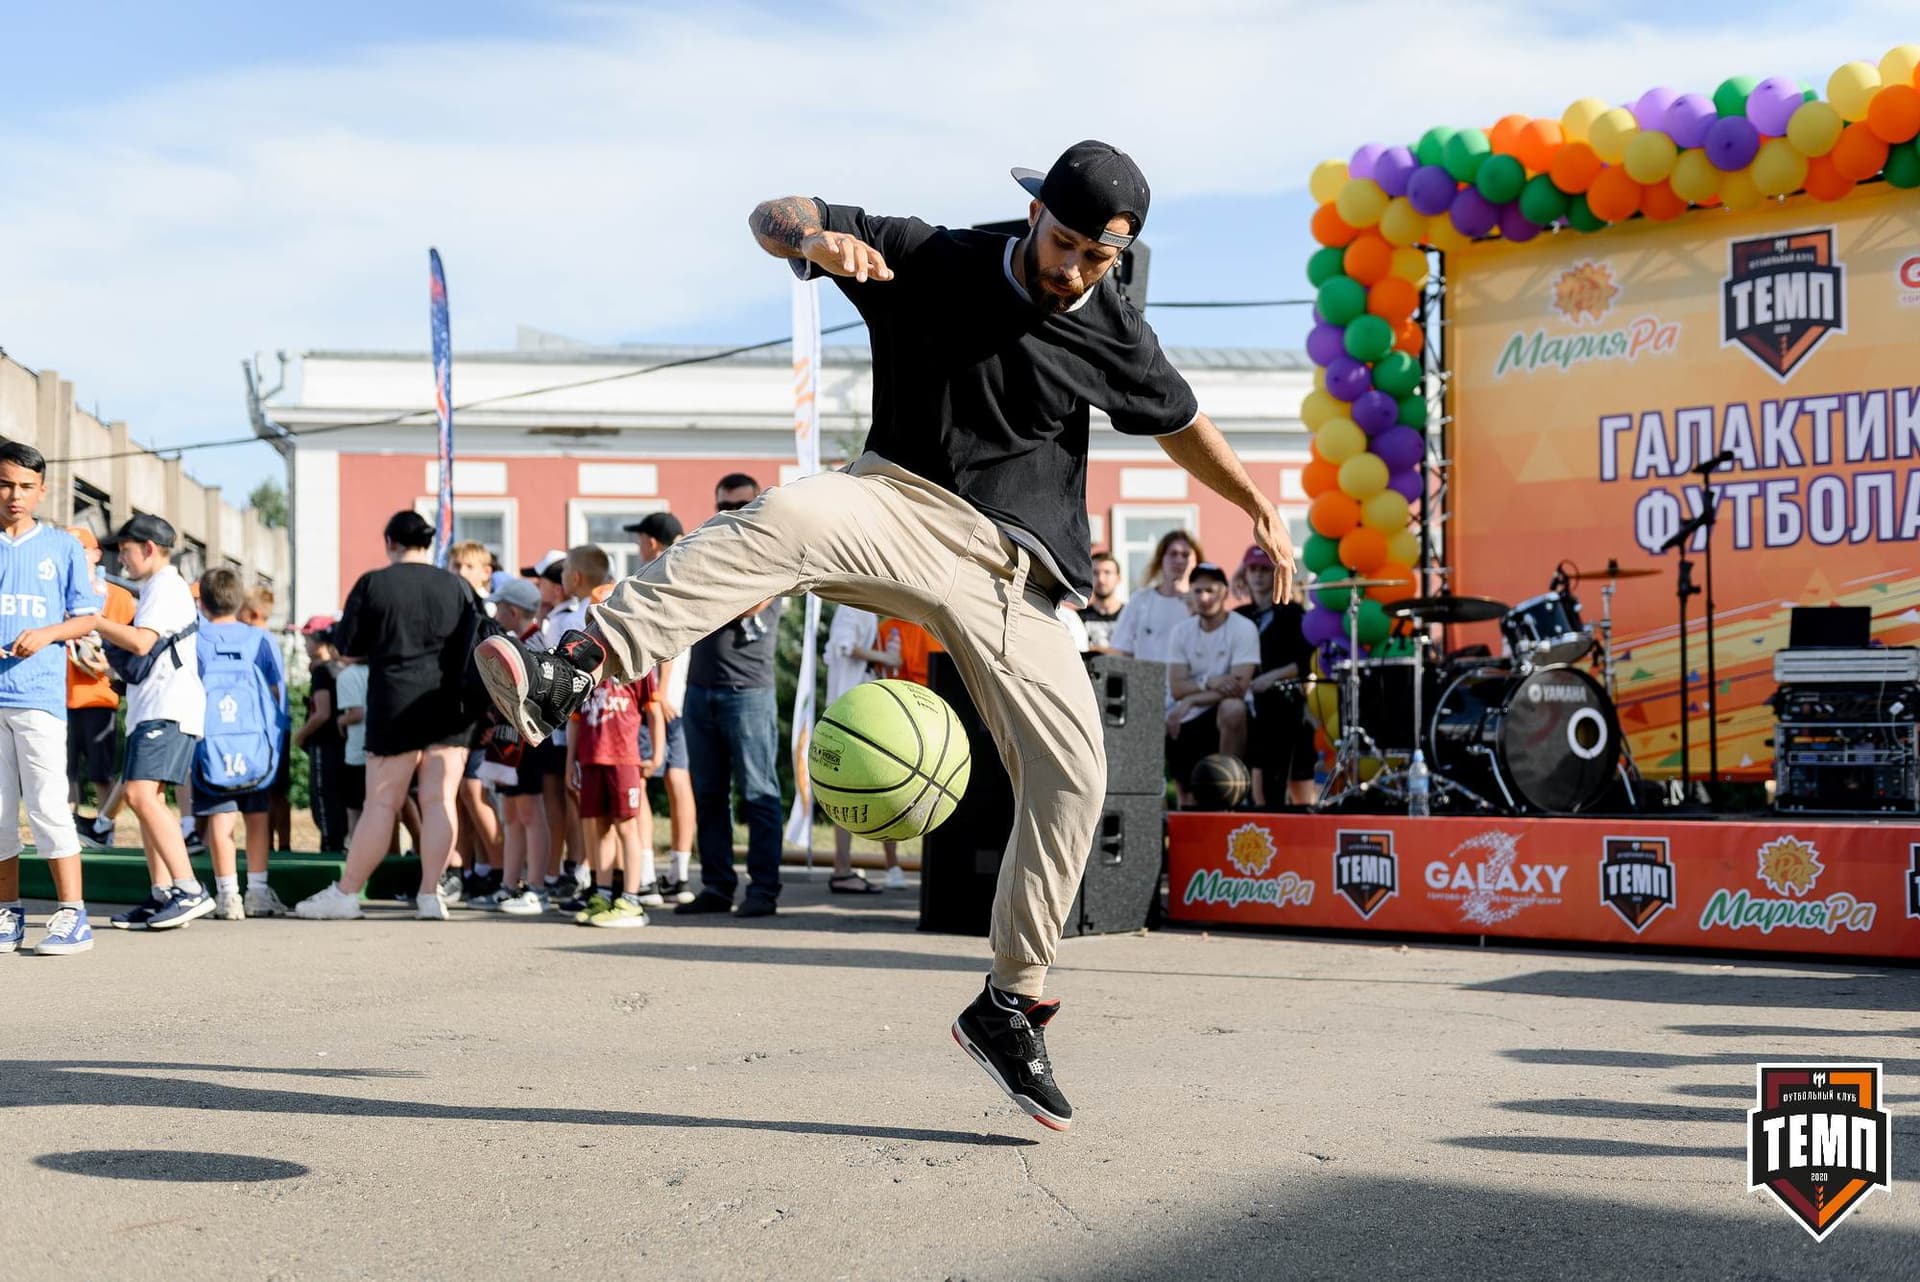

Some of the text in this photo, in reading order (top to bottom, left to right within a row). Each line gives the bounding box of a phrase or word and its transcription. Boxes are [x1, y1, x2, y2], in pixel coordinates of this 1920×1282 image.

[1731, 271, 1834, 331] ТЕМП
[0, 593, 47, 619] ВТБ
[1543, 684, 1587, 703] YAMAHA
[223, 752, 247, 777] 14
[1339, 855, 1392, 888] ТЕМП
[1424, 861, 1569, 894] GALAXY
[1606, 863, 1668, 899] ТЕМП
